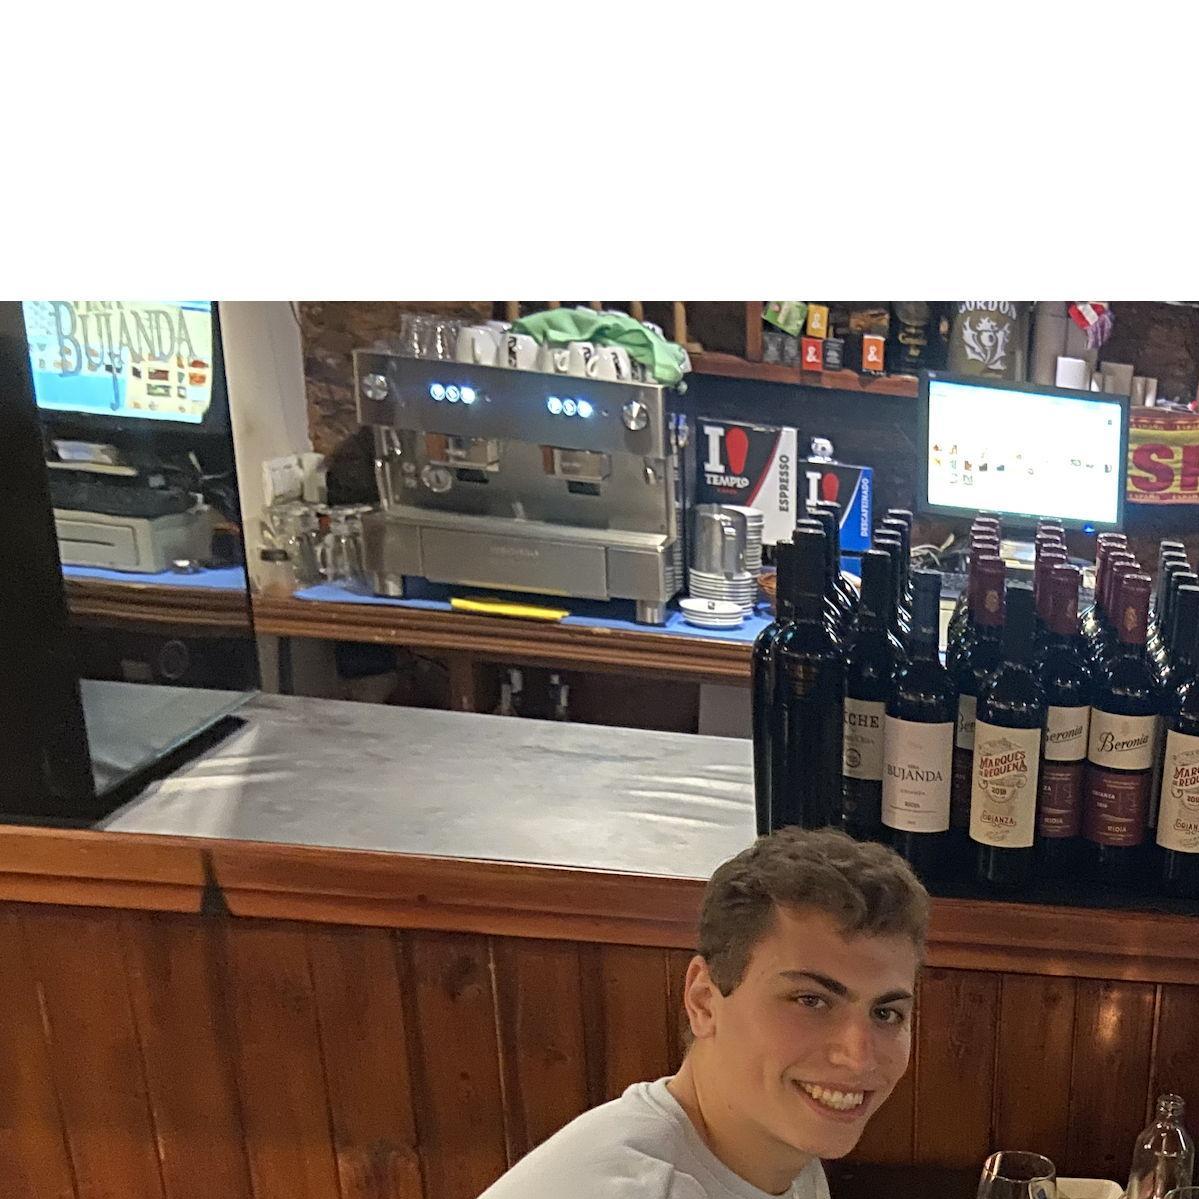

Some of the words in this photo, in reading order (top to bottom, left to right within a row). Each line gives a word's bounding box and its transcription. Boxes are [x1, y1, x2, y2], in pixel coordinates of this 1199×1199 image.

[779, 454, 790, 513] ESPRESSO
[1045, 725, 1083, 744] eronia
[1098, 731, 1150, 752] Beronia
[980, 750, 1026, 769] MARQUES
[887, 764, 943, 782] BUJANDA
